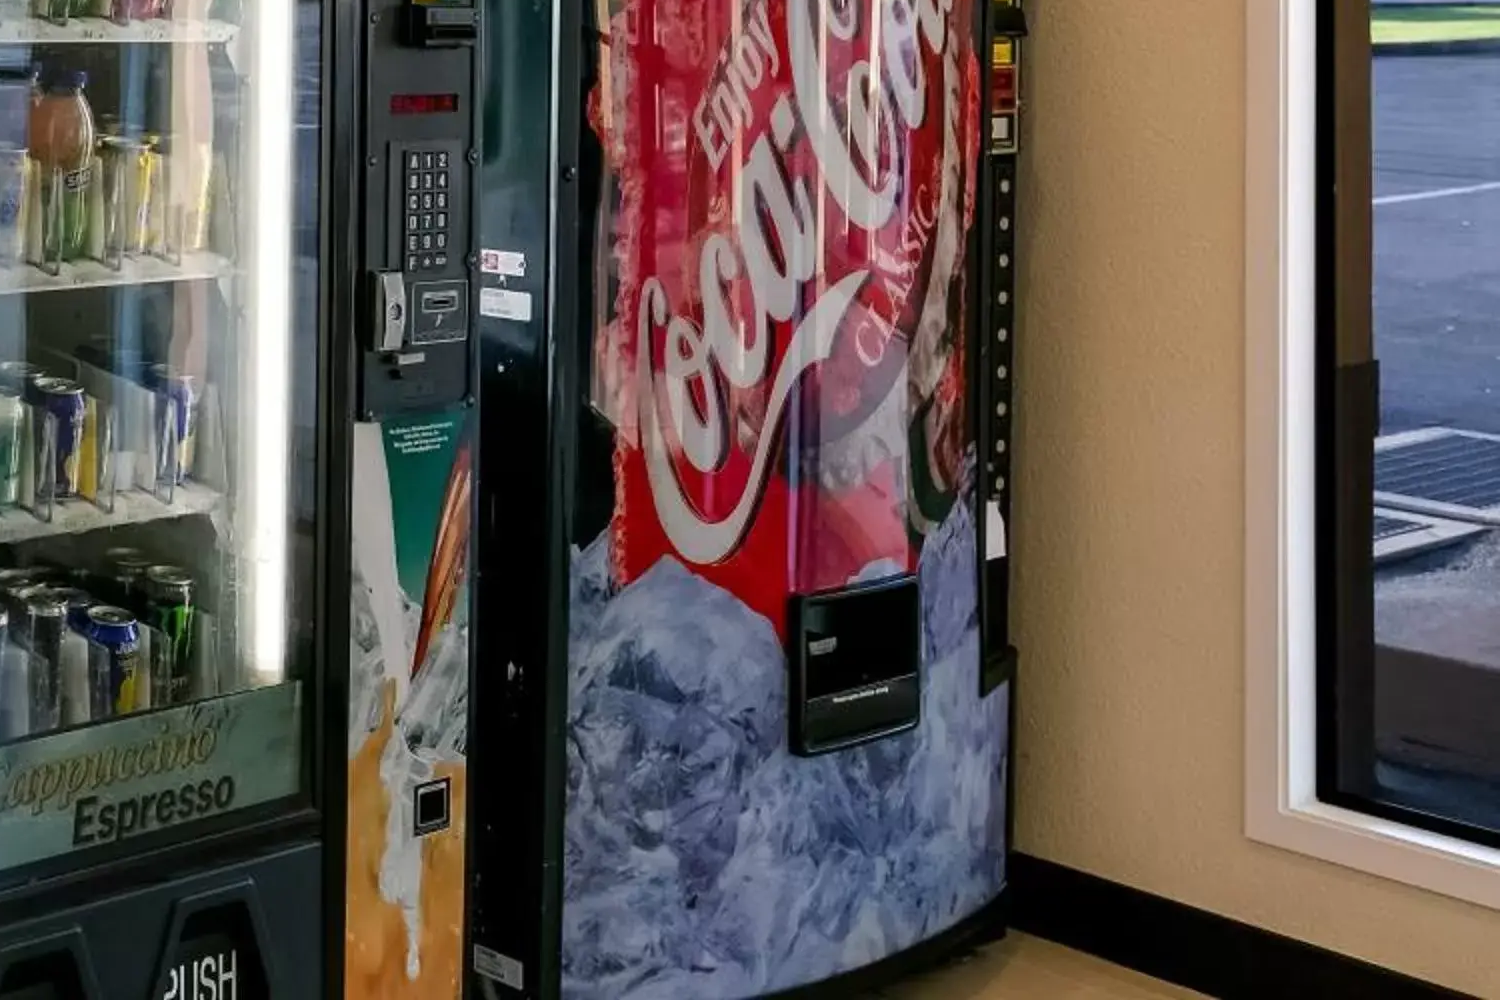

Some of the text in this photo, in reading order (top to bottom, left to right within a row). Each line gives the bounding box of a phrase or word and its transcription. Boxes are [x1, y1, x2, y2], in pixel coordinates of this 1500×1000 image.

[410, 153, 447, 169] A 1 2
[424, 174, 432, 189] 3
[438, 173, 446, 188] 4
[423, 215, 431, 229] 7
[409, 236, 418, 250] E
[408, 257, 417, 271] F
[854, 175, 946, 369] CLASSIC
[72, 775, 236, 847] Espresso
